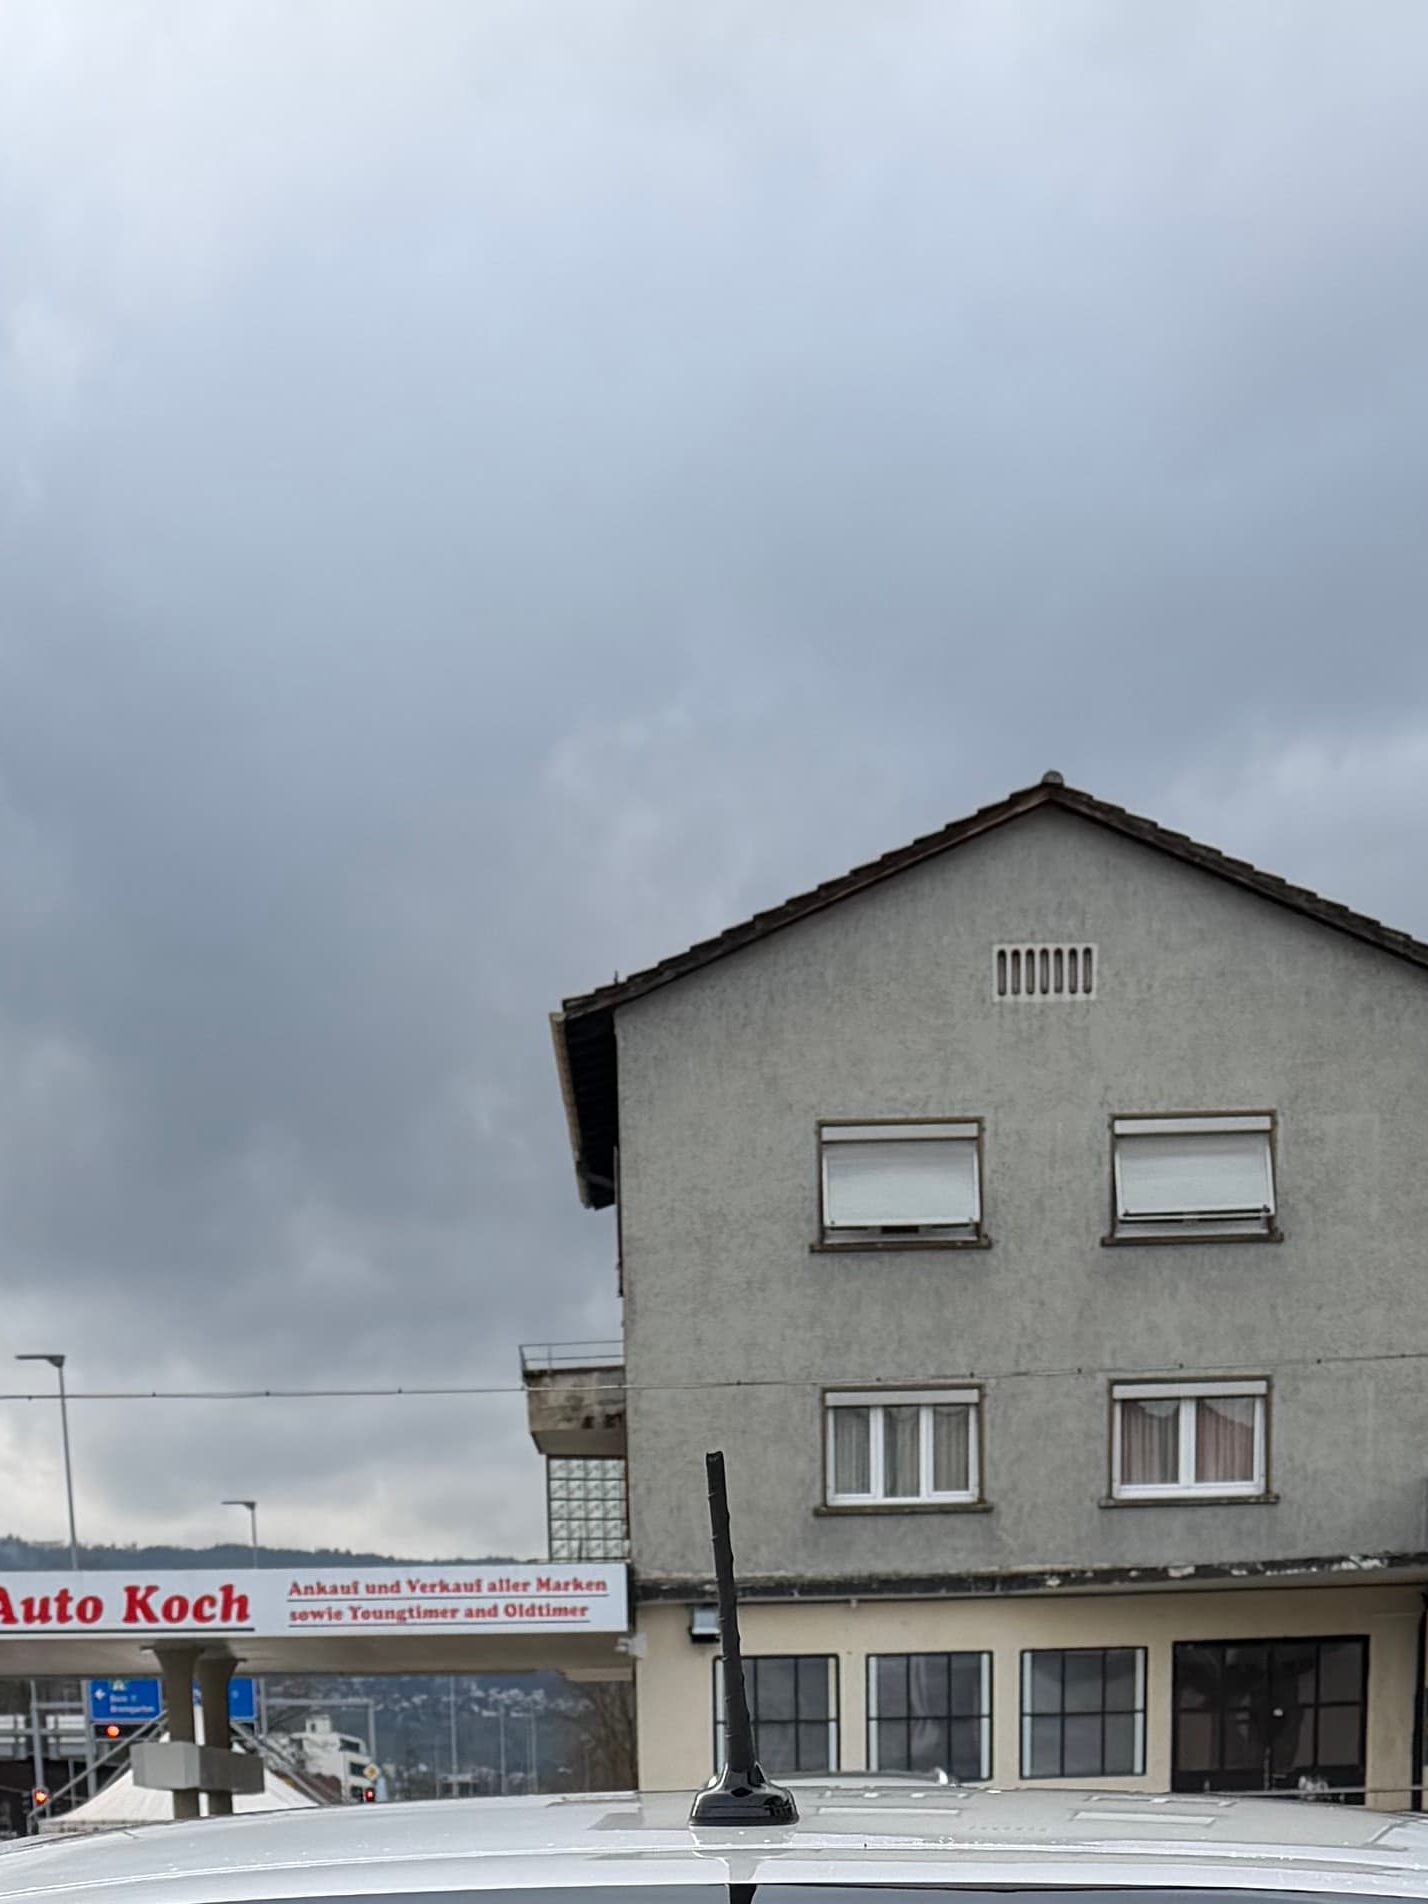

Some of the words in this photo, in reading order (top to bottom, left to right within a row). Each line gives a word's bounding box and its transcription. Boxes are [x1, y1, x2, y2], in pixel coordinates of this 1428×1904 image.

[288, 1580, 359, 1596] Ankauf
[365, 1580, 401, 1594] und
[406, 1578, 482, 1594] Verkauf
[487, 1578, 531, 1593] aller
[536, 1577, 608, 1592] Marken
[122, 1584, 250, 1624] Koch
[289, 1606, 343, 1621] sowie
[348, 1604, 460, 1623] Youngtimer
[503, 1602, 589, 1618] Oldtimer
